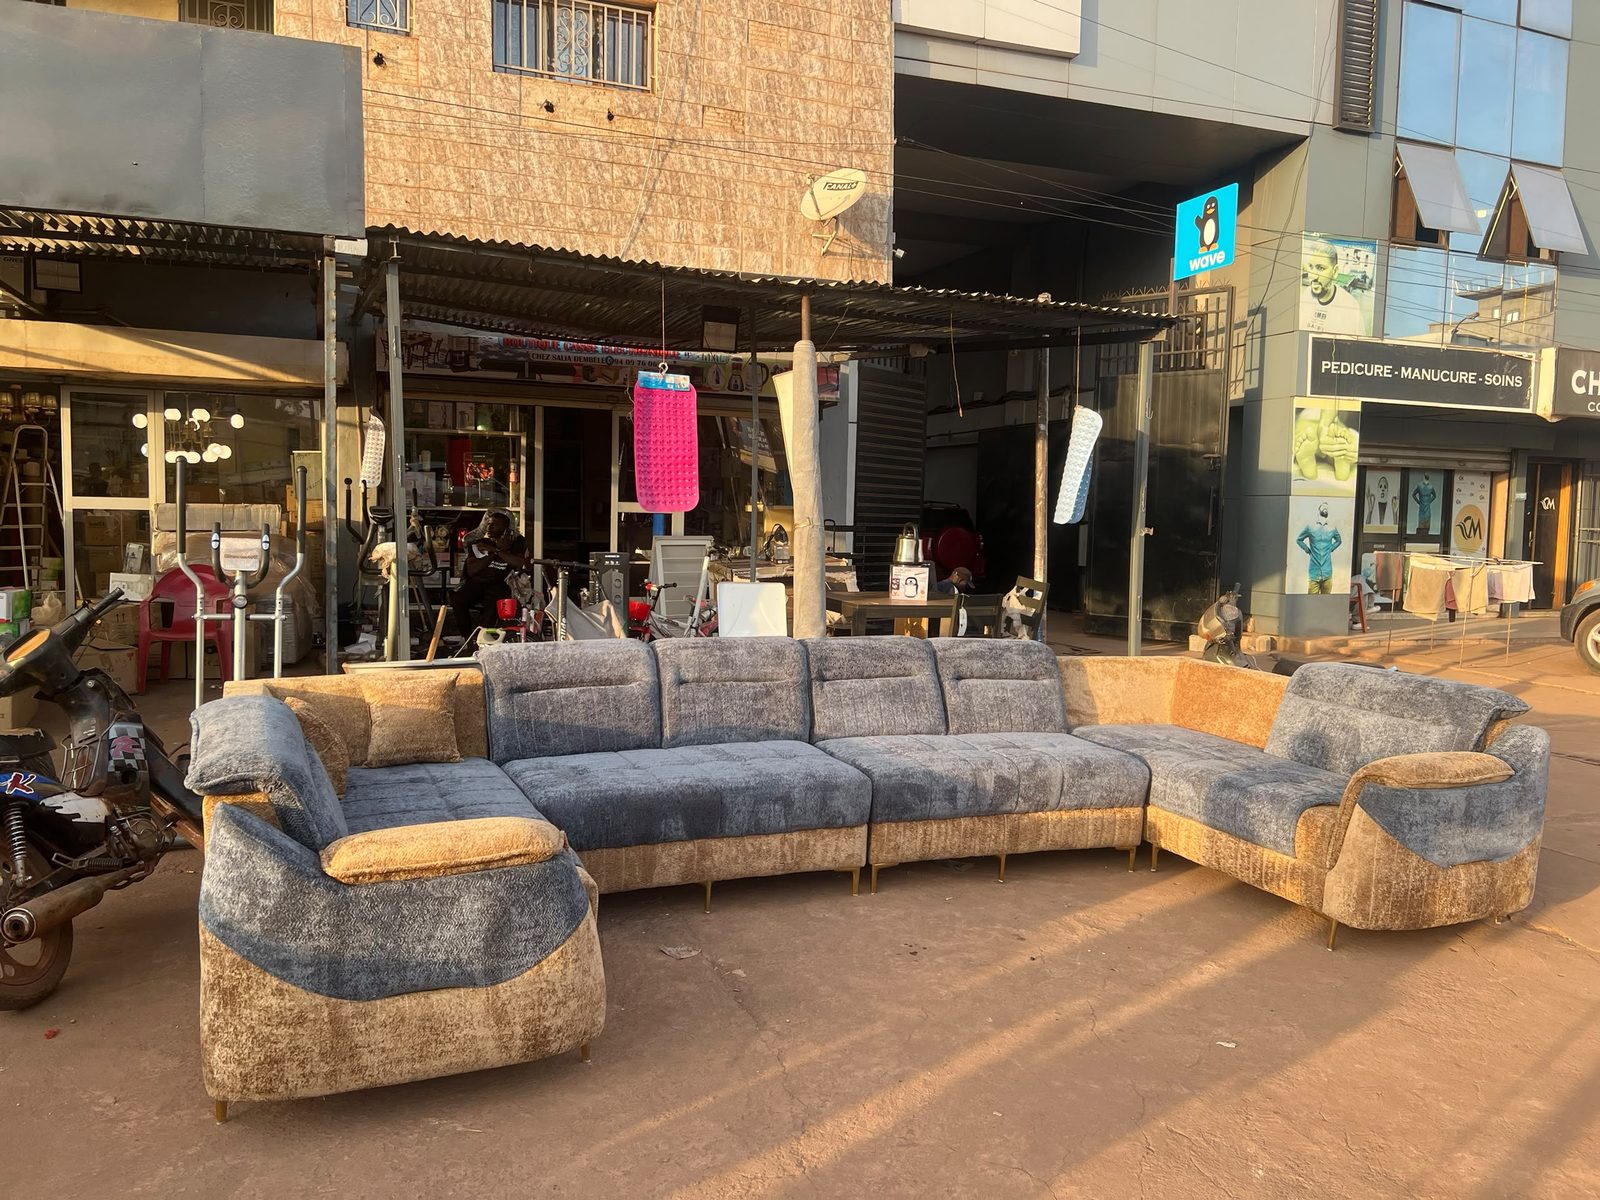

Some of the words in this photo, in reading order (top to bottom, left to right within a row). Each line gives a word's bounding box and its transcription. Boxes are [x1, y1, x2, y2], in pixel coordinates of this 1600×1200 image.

[825, 182, 857, 190] CANAL+
[1189, 250, 1226, 272] wave
[531, 352, 550, 361] CHEZ
[552, 353, 572, 362] SALIA
[1321, 360, 1393, 378] PEDICURE
[1401, 366, 1477, 384] MANUCURE
[1484, 373, 1523, 387] SOINS
[1571, 369, 1600, 396] CH
